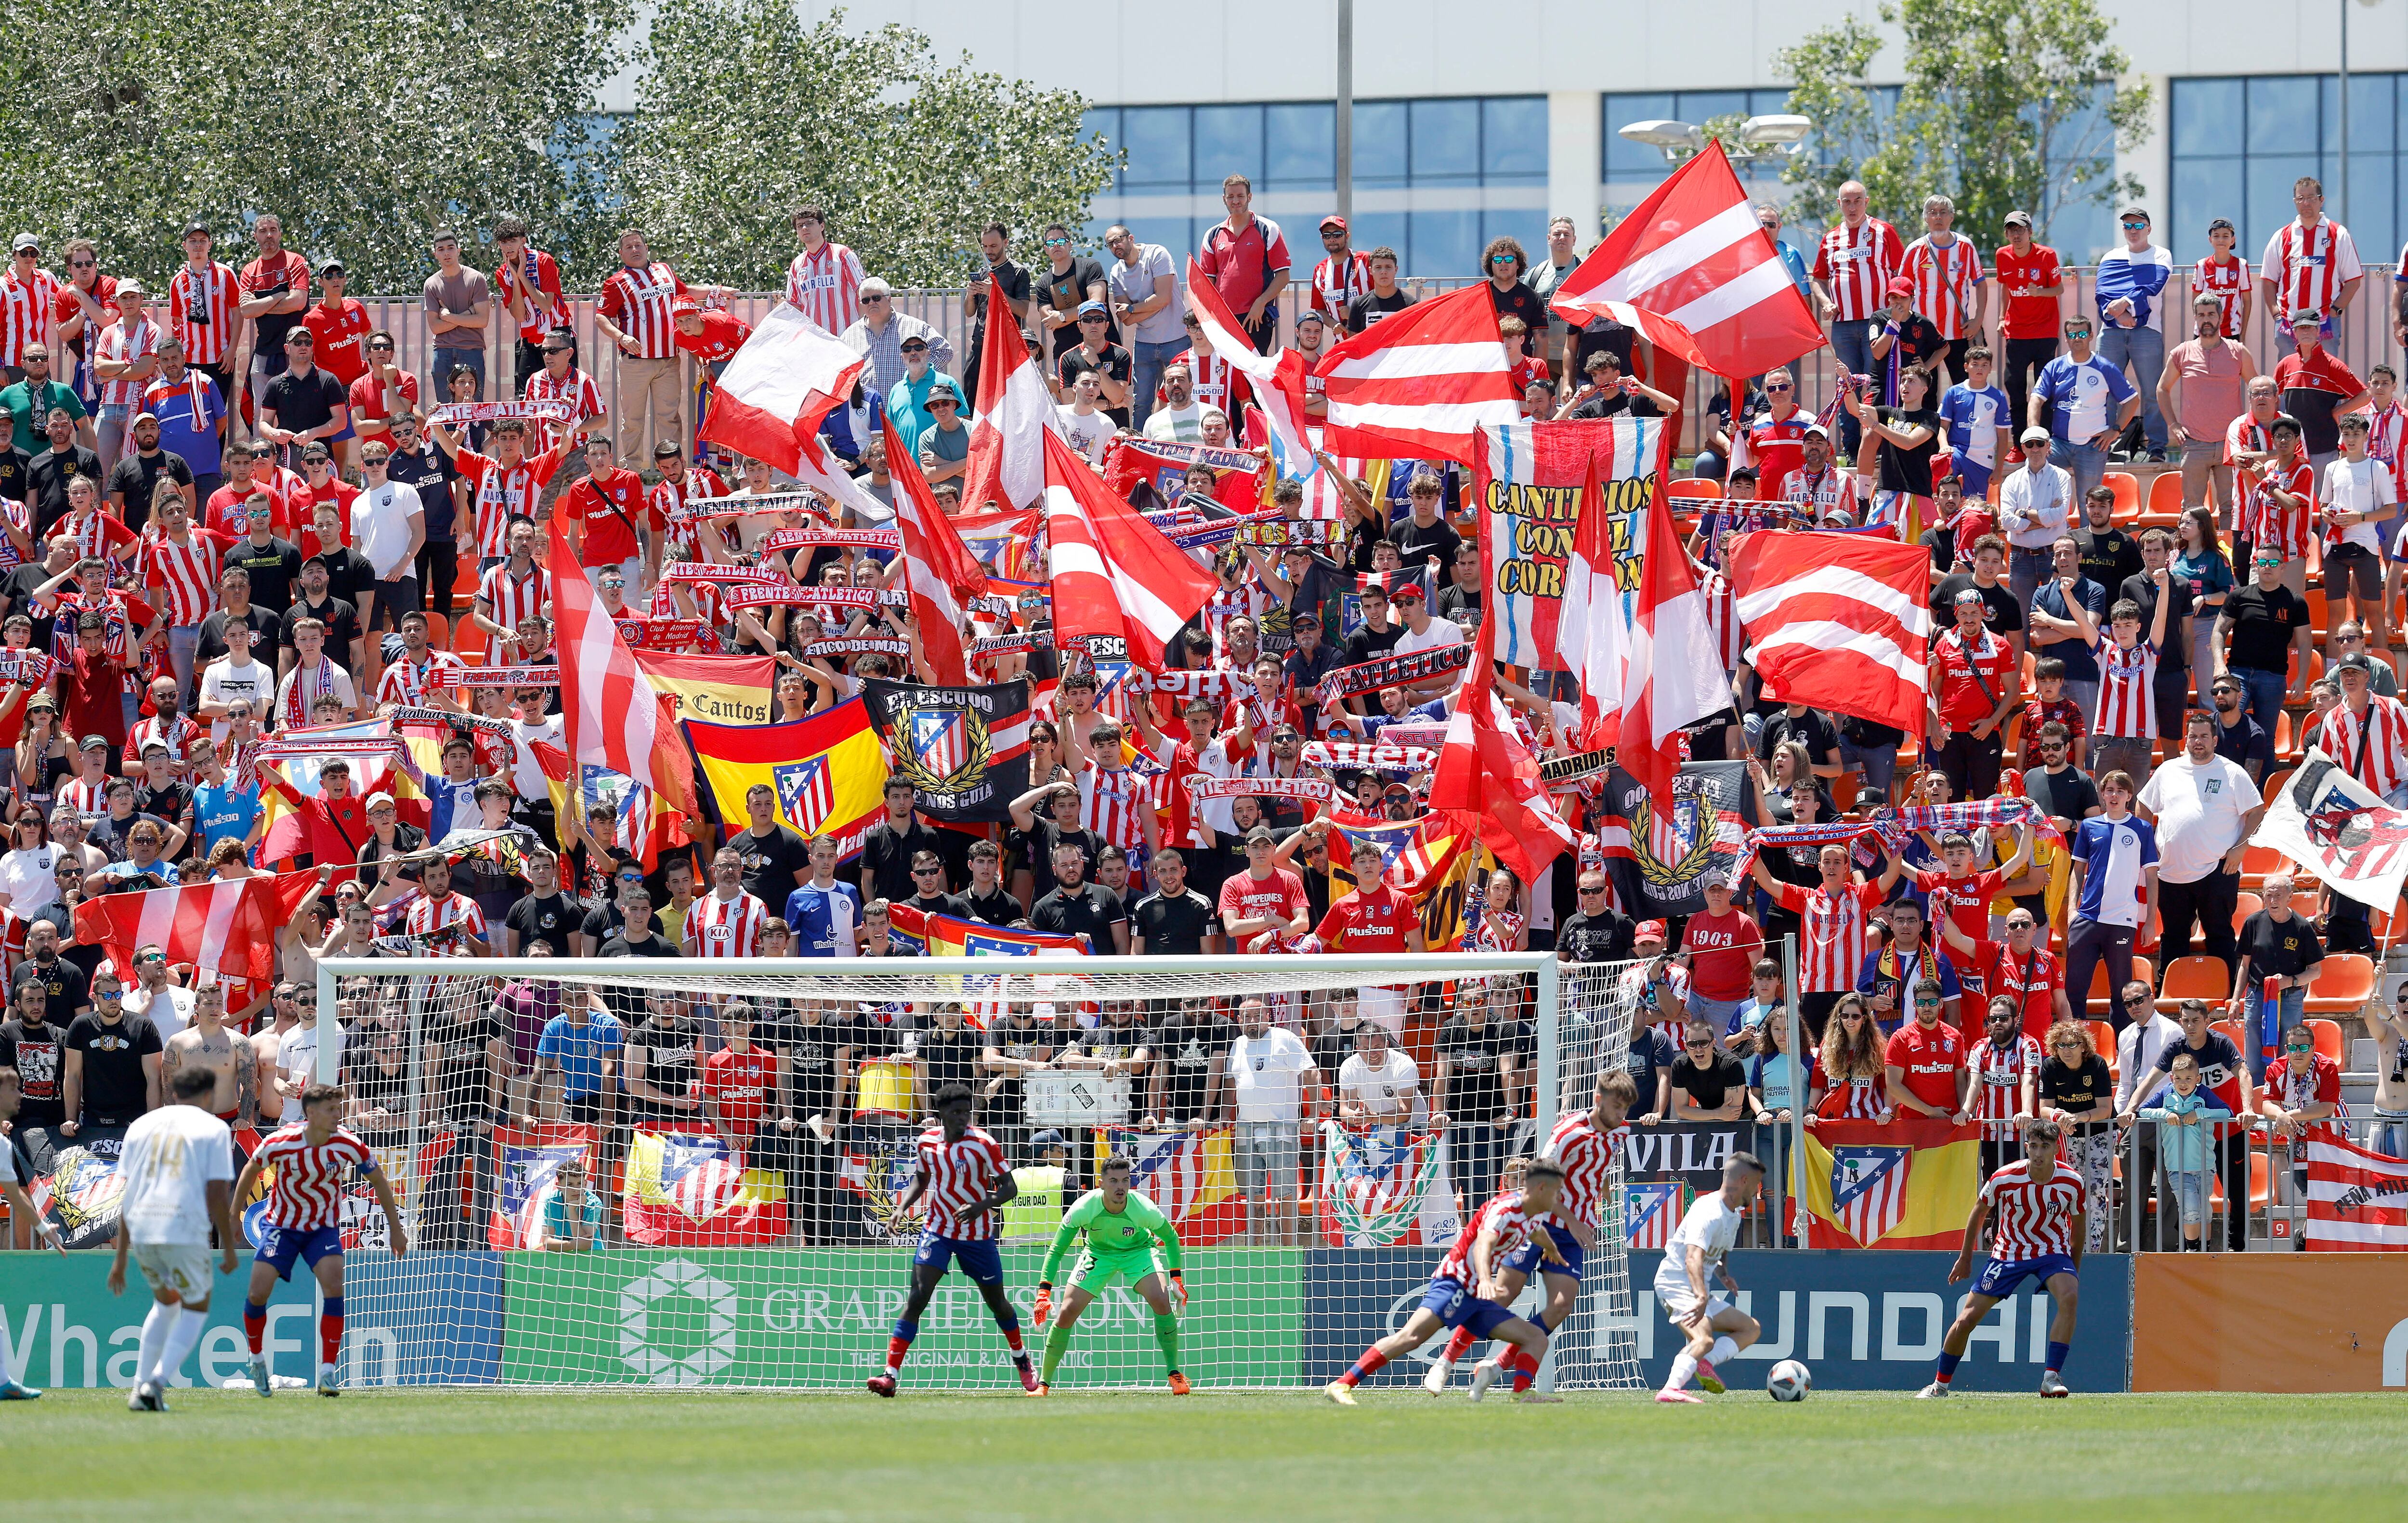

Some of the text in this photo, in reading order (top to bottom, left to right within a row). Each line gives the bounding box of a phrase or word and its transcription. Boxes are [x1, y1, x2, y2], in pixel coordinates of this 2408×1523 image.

[1835, 249, 1871, 261] Plus500
[641, 287, 674, 301] Plus500
[1199, 448, 1260, 472] MADRID
[1791, 492, 1836, 503] MARELLA
[588, 504, 626, 520] Plus50
[686, 500, 738, 519] FRENTE
[740, 587, 789, 602] FRENTE
[1212, 603, 1247, 612] AZERBAIJAN
[665, 631, 688, 640] Madrid
[850, 640, 870, 651] DE
[463, 671, 509, 683] FRENTE
[1949, 667, 1994, 678] Plus00
[692, 694, 767, 722] Cantos
[886, 690, 993, 713] EL ESCUDO
[926, 782, 993, 809] NOS GUÍA
[1035, 799, 1045, 814] LOLA
[203, 813, 239, 828] Plus500
[837, 814, 885, 858] Madrid
[1822, 829, 1859, 840] MADRID
[1240, 893, 1283, 906] CAMPEONES
[710, 929, 730, 937] KIA
[1347, 924, 1393, 937] Plus500
[1692, 930, 1732, 947] 1903
[1911, 1061, 1954, 1073] Plus500
[2057, 1094, 2093, 1103] Plus500
[1012, 1195, 1047, 1208] SEGURDAD
[2333, 1186, 2372, 1216] PEÑA
[2276, 1223, 2284, 1234] 9
[268, 1228, 281, 1246] 4
[1983, 1261, 2003, 1280] 14
[1451, 1288, 1464, 1307] 8
[850, 1352, 879, 1366] THE
